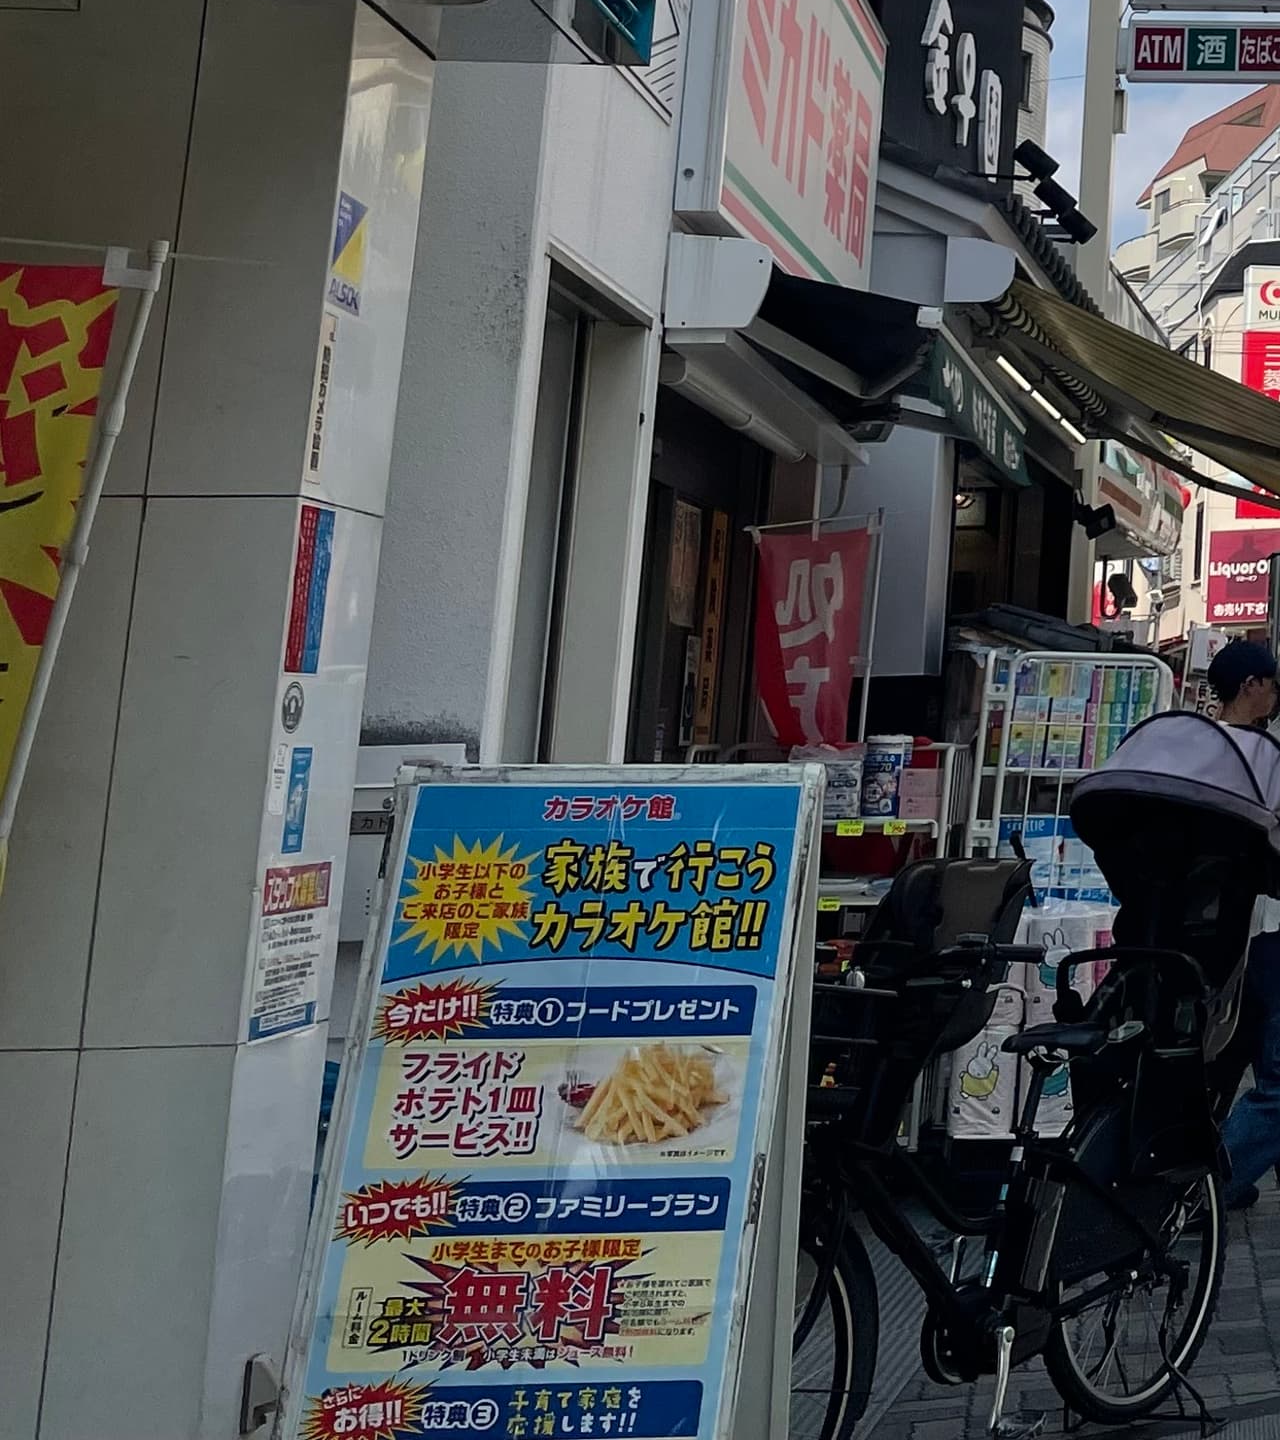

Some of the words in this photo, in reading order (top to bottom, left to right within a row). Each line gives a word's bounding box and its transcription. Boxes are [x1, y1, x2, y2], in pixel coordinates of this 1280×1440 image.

[1137, 35, 1182, 64] ATM
[1197, 35, 1228, 65] 酒
[543, 795, 676, 822] カラオケ館
[418, 862, 527, 882] 小学生以下の
[543, 837, 777, 895] 家族で行こう
[433, 882, 505, 901] お子様と
[401, 901, 529, 921] ご来店のご家族
[443, 921, 481, 941] 限定
[529, 898, 768, 952] カラオケ館!!
[402, 1050, 520, 1082] フライド
[393, 1085, 540, 1115] ポテト1皿
[431, 1238, 643, 1262] 小学生までのお子様限定
[436, 1265, 614, 1345] 無料
[321, 1384, 363, 1410] さらに
[508, 1386, 642, 1411] 子育て家庭を
